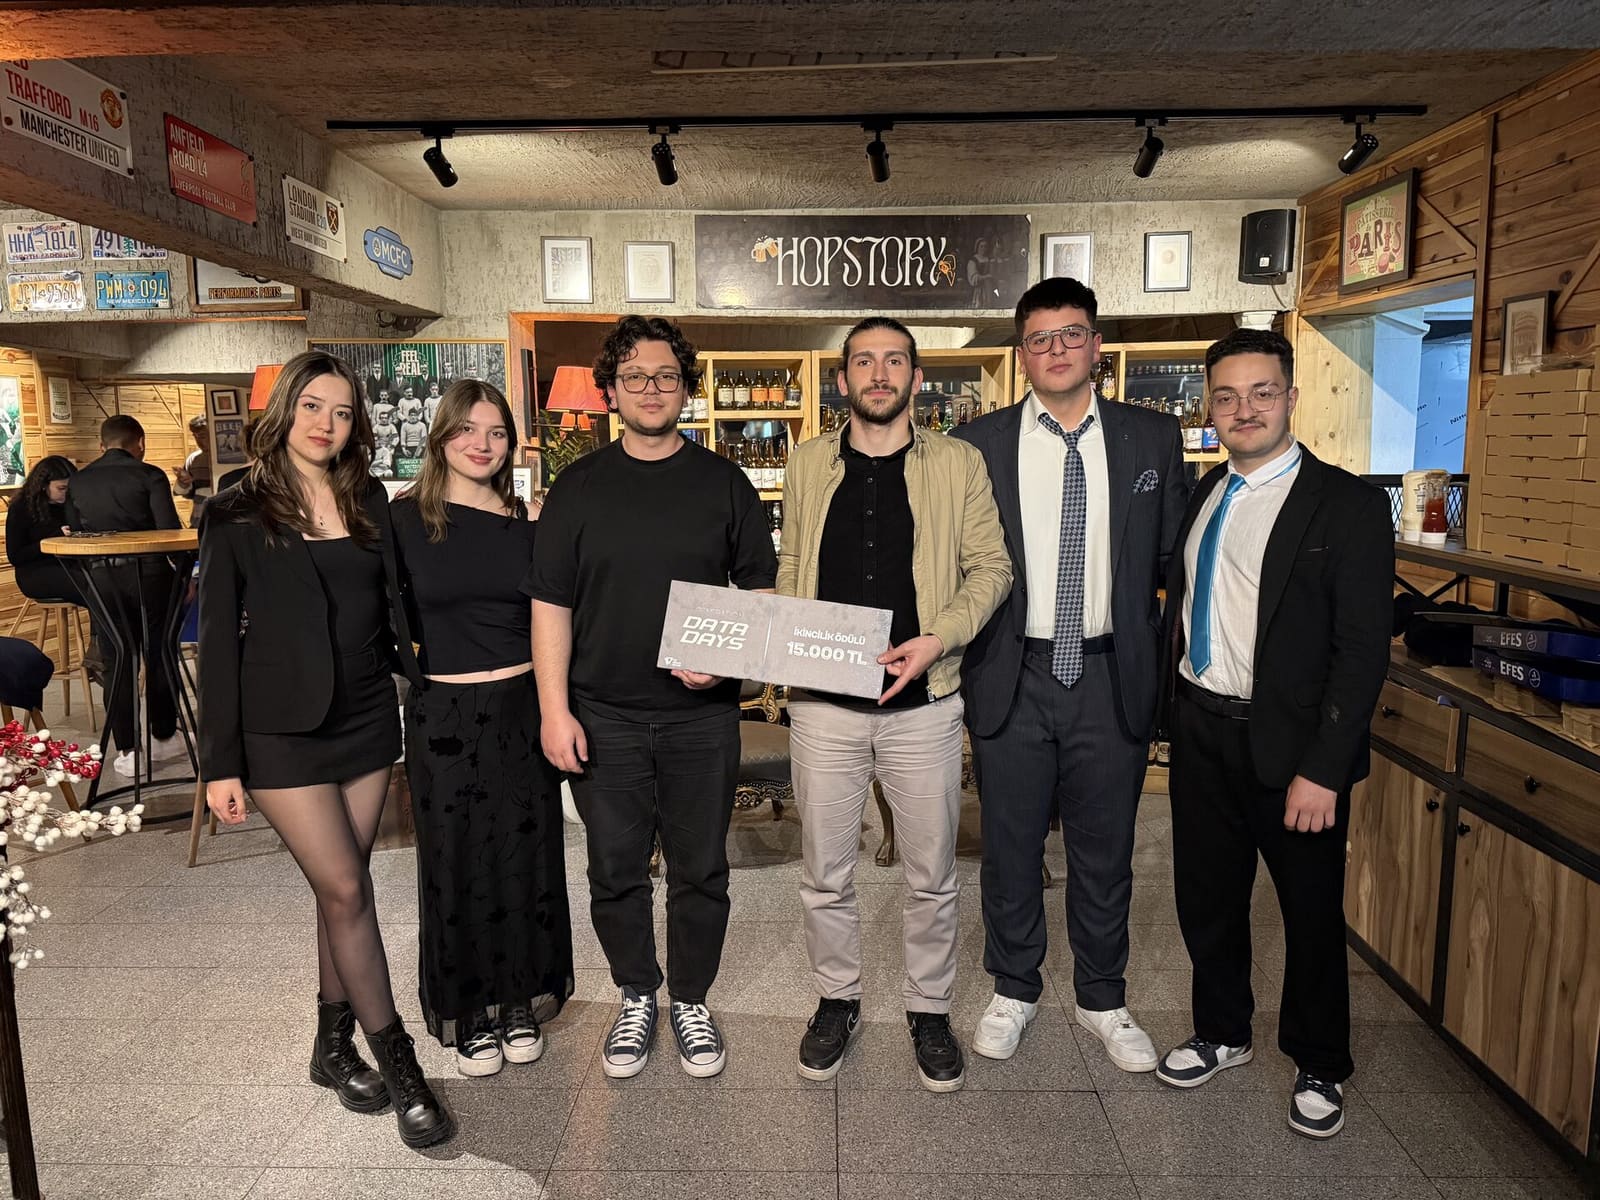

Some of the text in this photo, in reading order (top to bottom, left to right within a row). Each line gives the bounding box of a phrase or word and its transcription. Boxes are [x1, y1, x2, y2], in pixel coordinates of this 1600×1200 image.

[5, 68, 100, 132] TRAFFORD M16
[20, 109, 120, 168] MANCHESTER UNITED
[170, 123, 205, 153] ANFIELD
[172, 147, 208, 178] ROAD L4
[174, 177, 202, 197] LIVERPOOL
[202, 188, 224, 207] FOOTBALL
[287, 183, 317, 212] LONDON
[289, 202, 316, 226] STADIUM
[8, 230, 77, 253] HHA-1814
[381, 240, 408, 269] MCFC
[776, 236, 947, 287] HOPSTORY
[208, 286, 281, 299] PERFORMANCE PARTS
[401, 350, 419, 362] FEEL
[400, 362, 422, 376] REAL
[682, 615, 750, 636] DATA
[793, 625, 866, 645] İKİNCİLİK ÖDÜLÜ
[680, 630, 747, 651] DAYS
[1500, 631, 1522, 647] EFES
[786, 641, 867, 666] 15.000 TL
[1500, 660, 1524, 681] EFES
